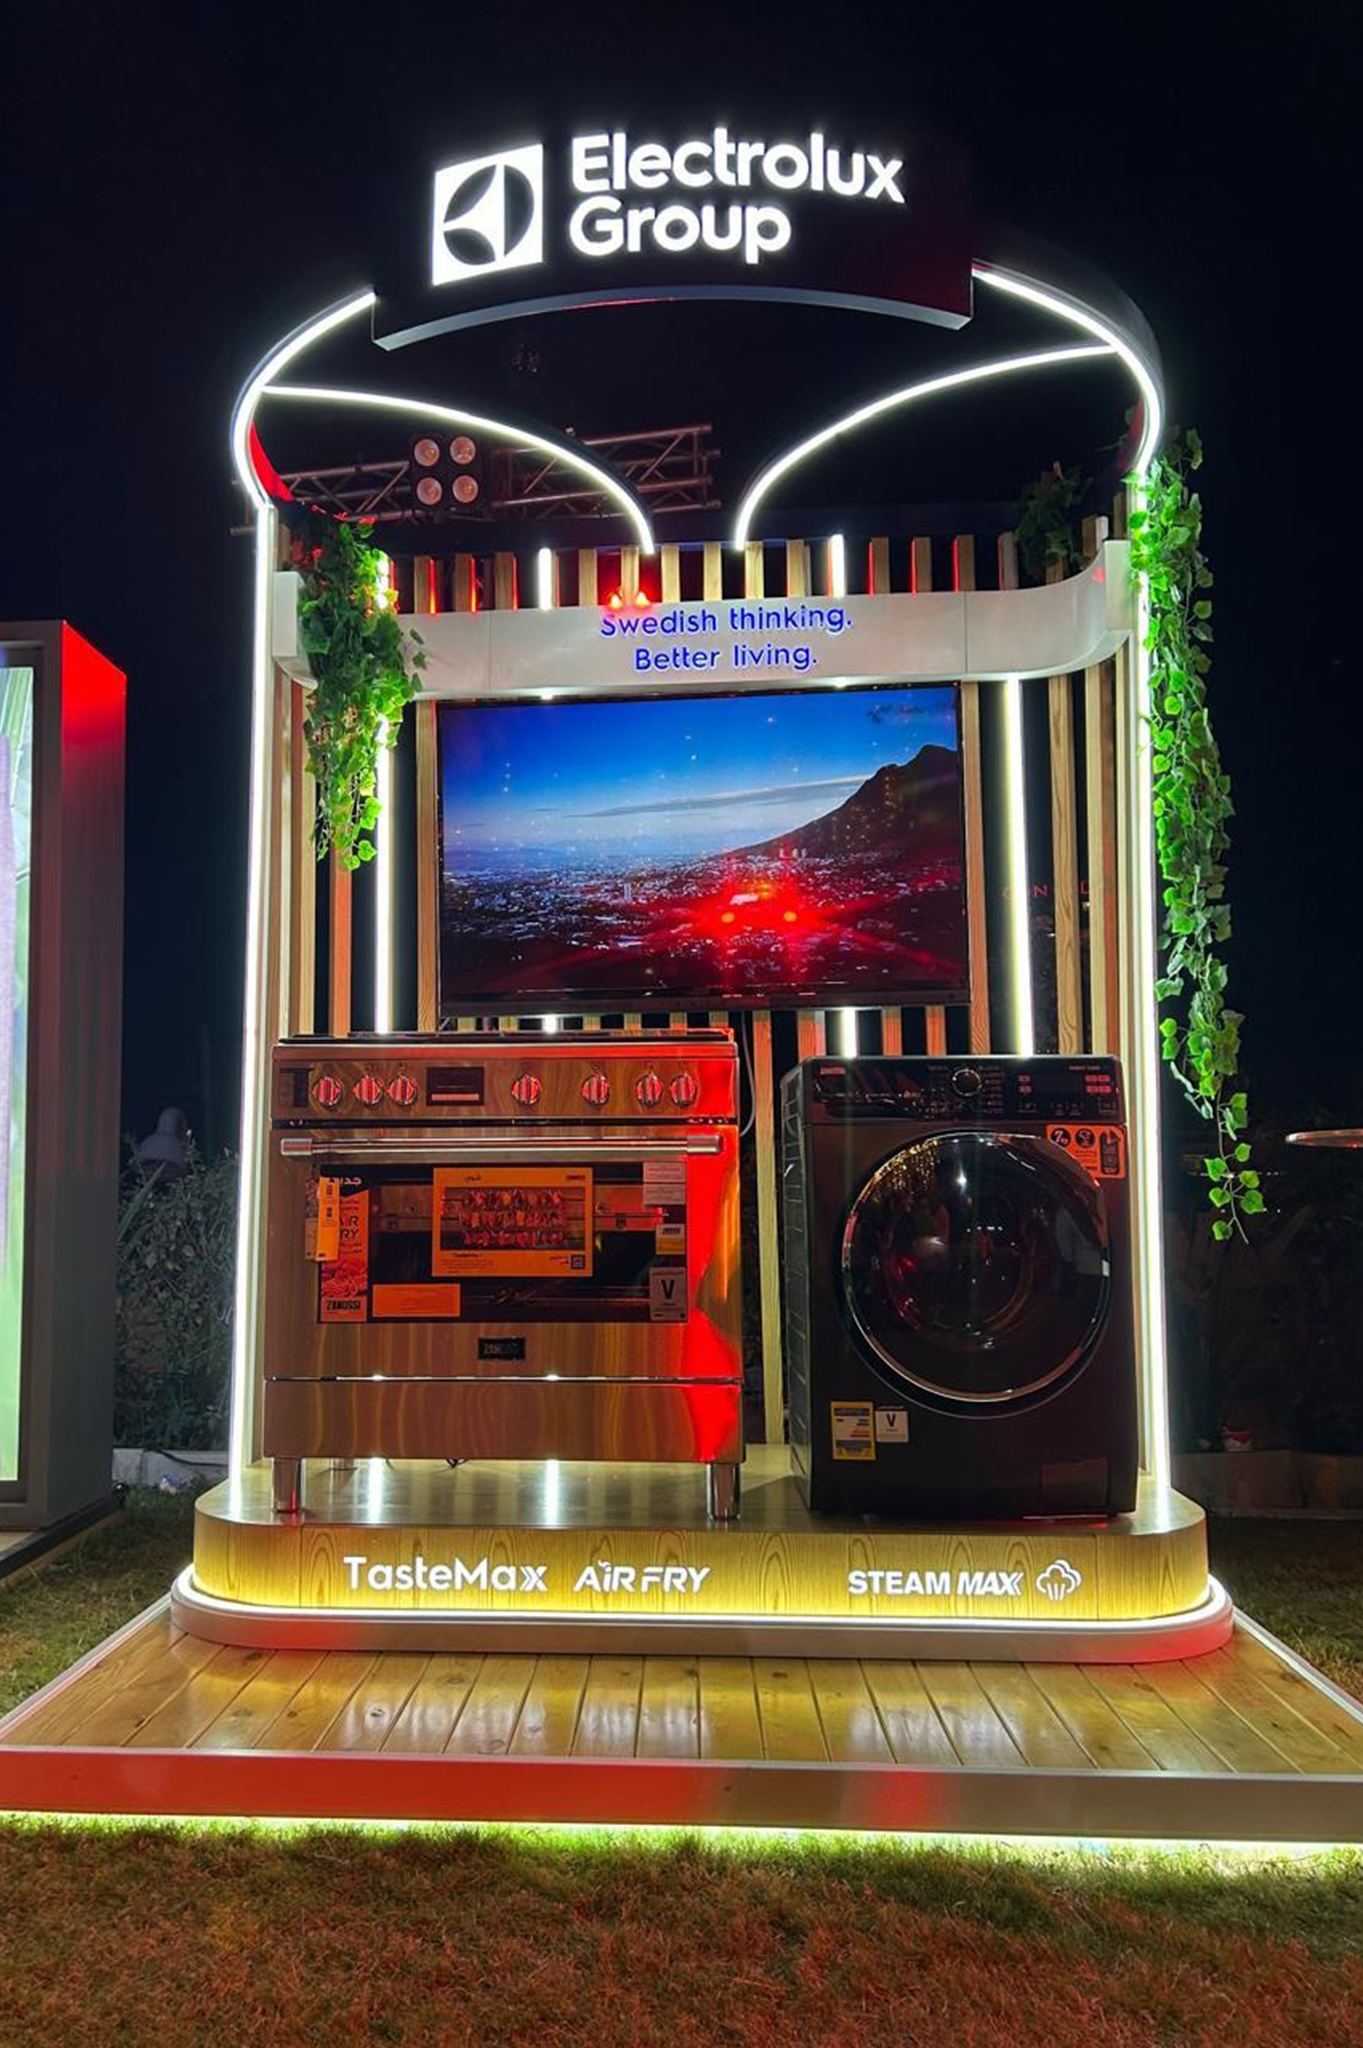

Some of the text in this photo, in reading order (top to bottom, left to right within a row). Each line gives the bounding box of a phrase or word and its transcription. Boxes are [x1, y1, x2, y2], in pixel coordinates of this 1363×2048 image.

[571, 127, 905, 203] Electrolux
[569, 195, 791, 264] Group
[600, 605, 852, 637] Swedish thinking.
[635, 644, 818, 671] Better living.
[661, 1279, 675, 1300] V
[886, 1413, 896, 1428] V
[343, 1556, 548, 1592] TasteMax
[641, 1566, 711, 1593] FRY
[848, 1570, 1024, 1596] STEAM MAX
